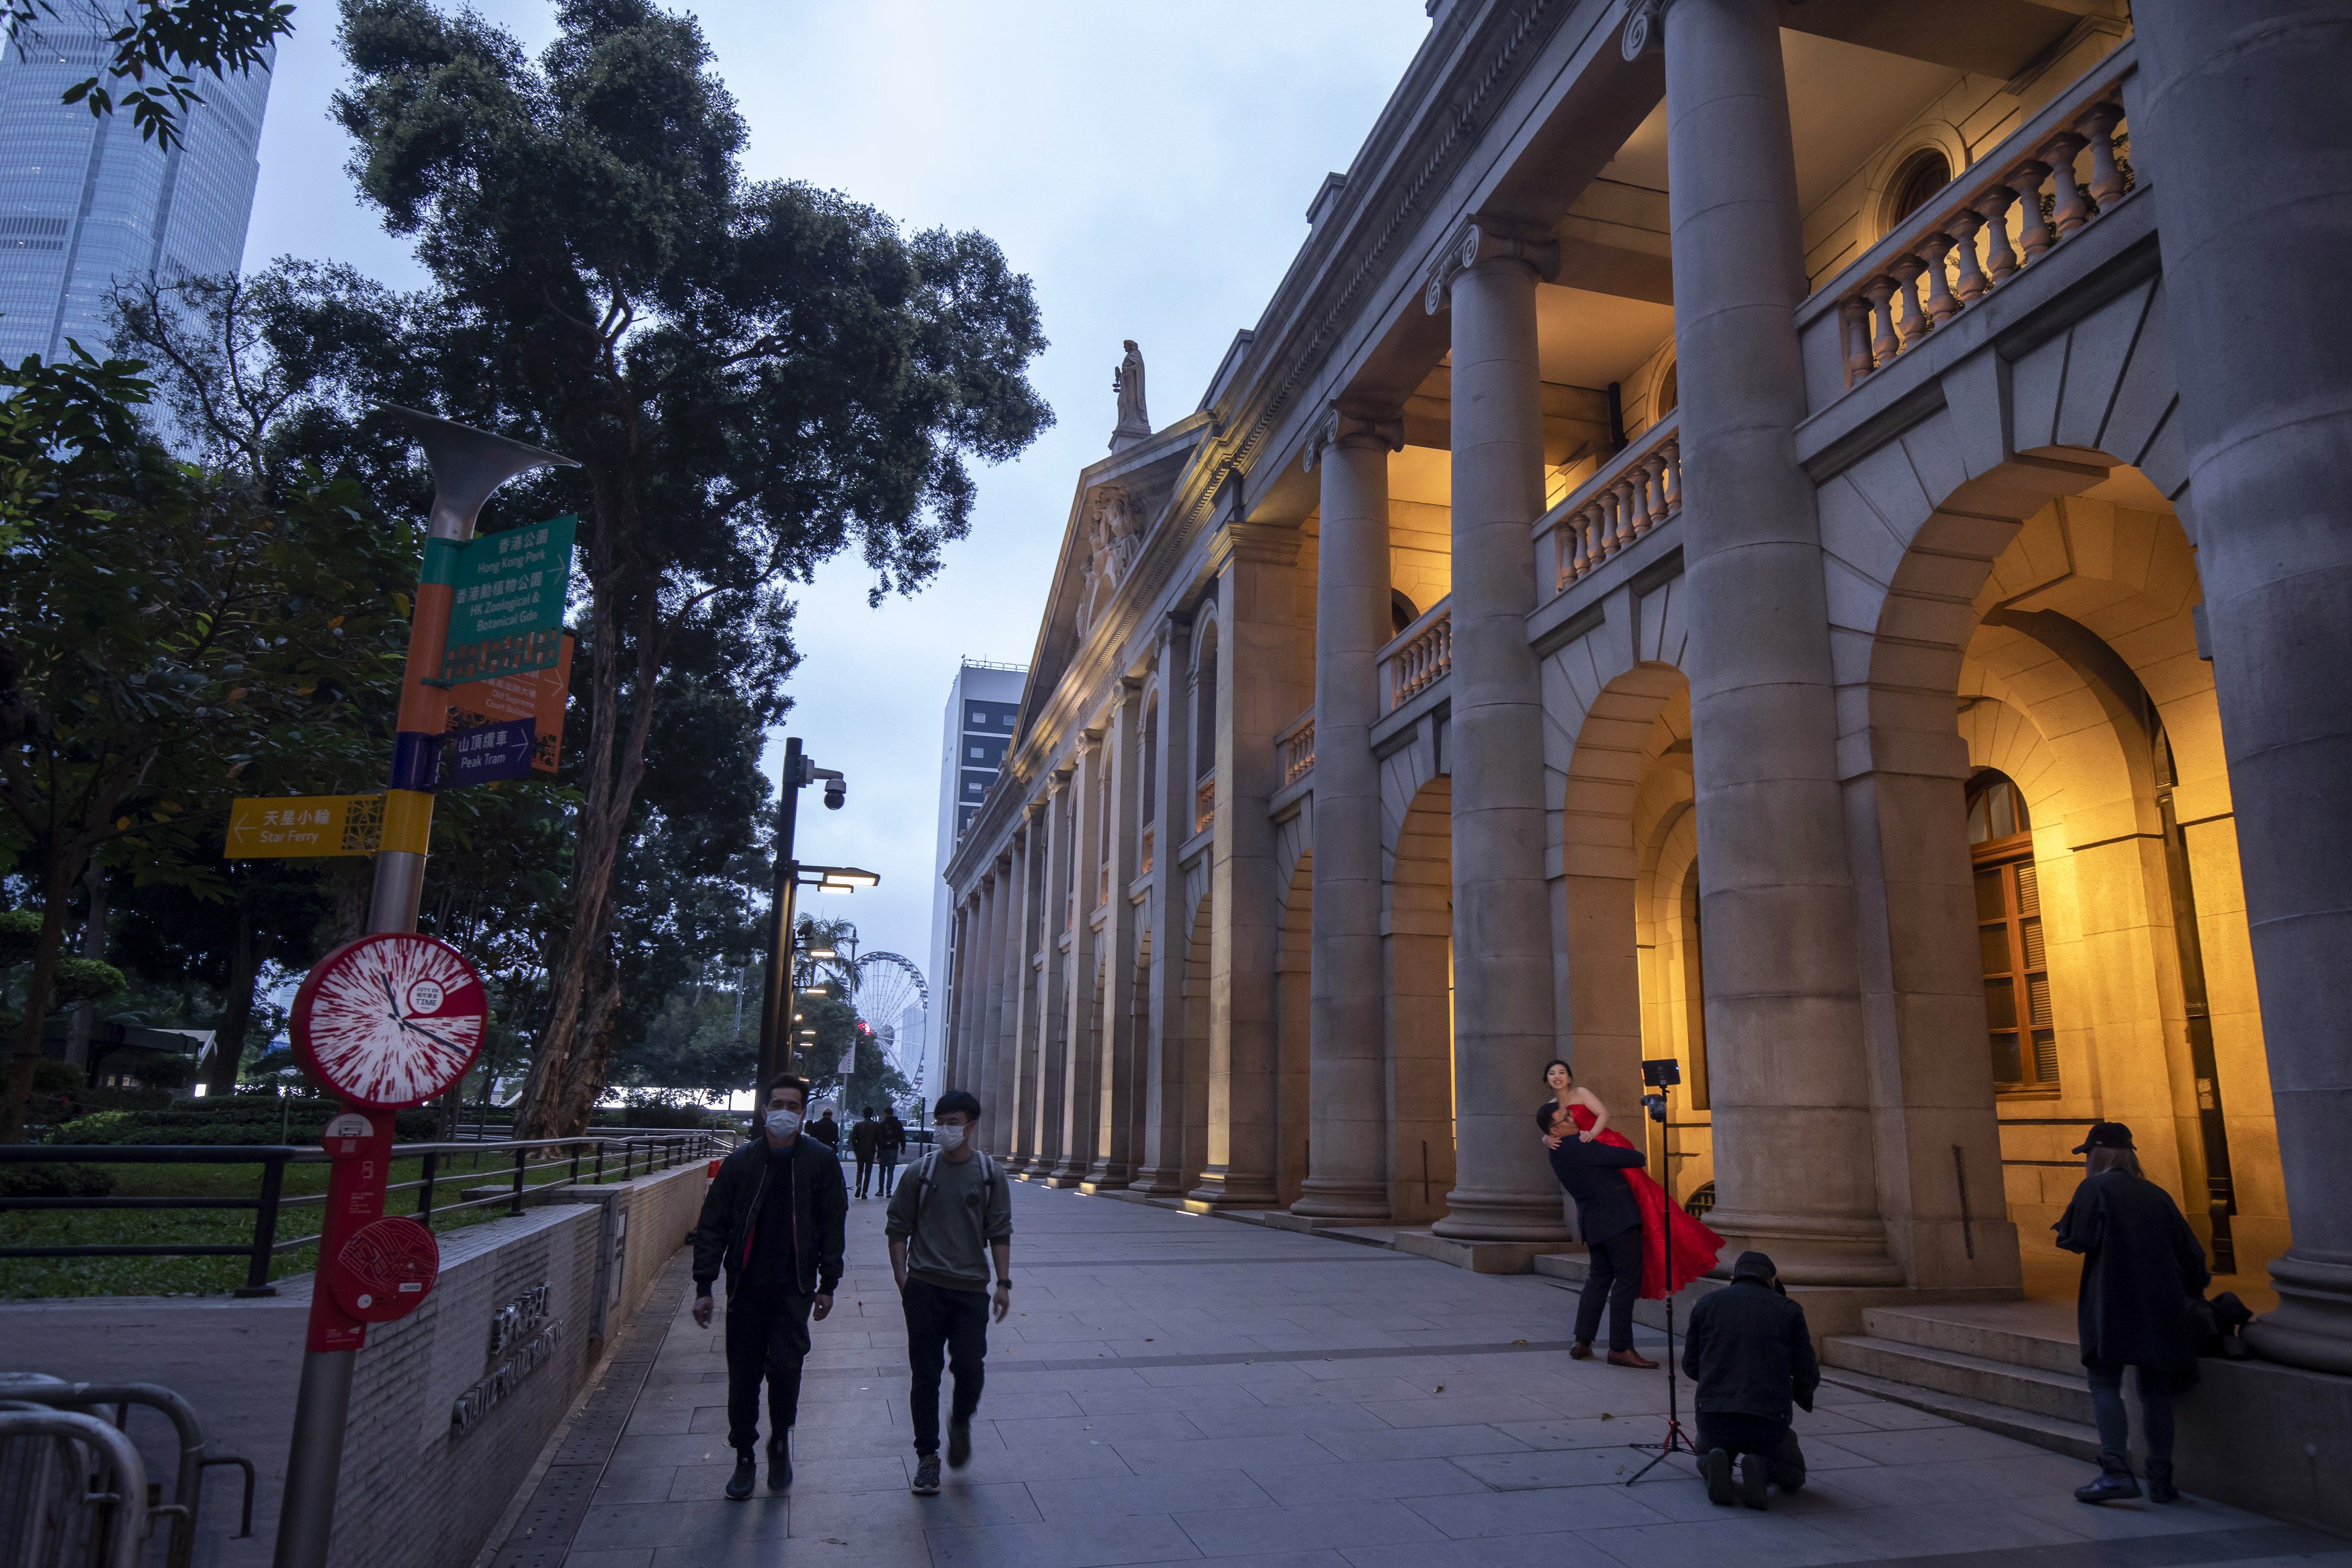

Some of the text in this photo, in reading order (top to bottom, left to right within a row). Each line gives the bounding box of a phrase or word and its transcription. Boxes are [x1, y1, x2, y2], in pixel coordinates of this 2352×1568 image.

[498, 529, 549, 554] 香港公園
[477, 549, 546, 574] Hong Kong Park
[457, 571, 543, 604] 香港動植物公園
[470, 591, 540, 617] HK Zoological &
[476, 609, 537, 632] Botanical Gdn
[486, 698, 505, 711] Court
[492, 689, 535, 709] Old Supreme
[458, 730, 508, 753] 山頂纜車
[461, 753, 506, 769] Peak Tram
[263, 808, 330, 826] 天星小輪
[259, 830, 319, 845] Star Ferry
